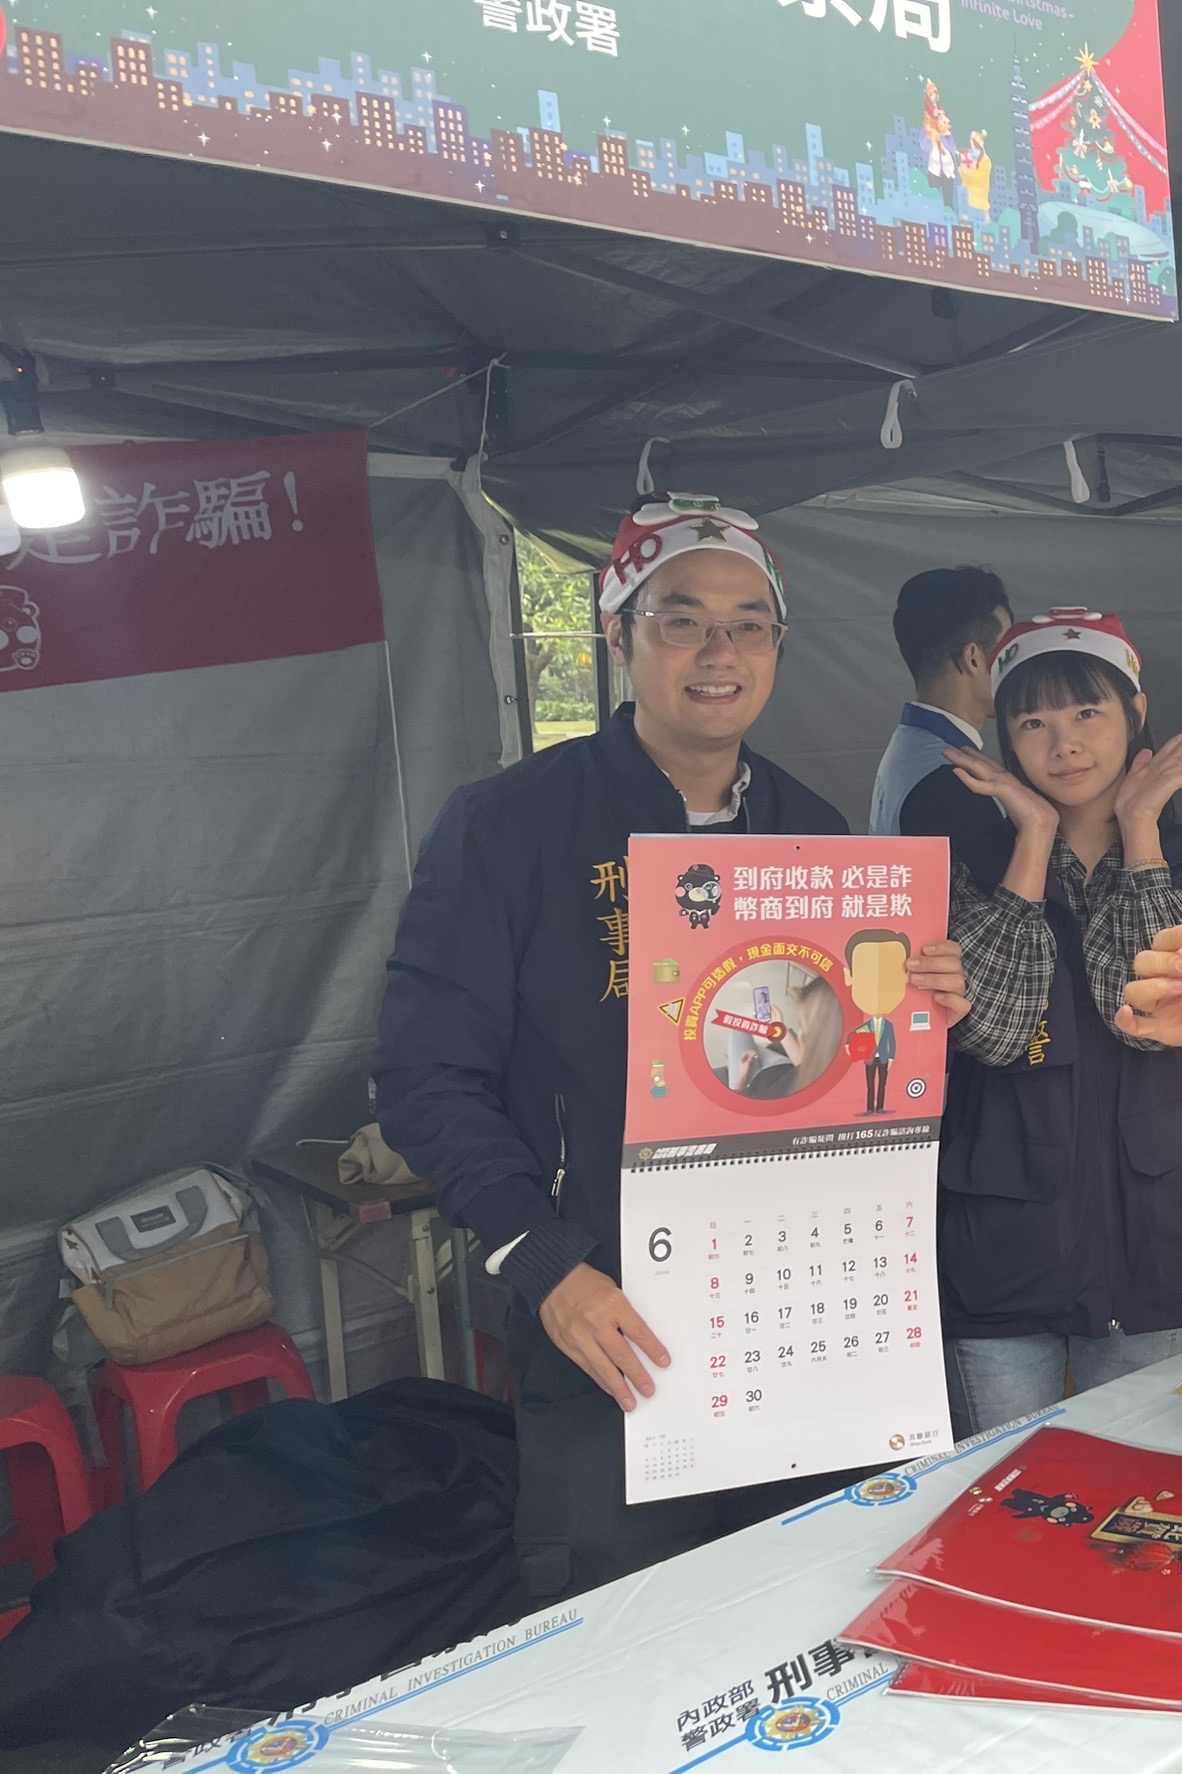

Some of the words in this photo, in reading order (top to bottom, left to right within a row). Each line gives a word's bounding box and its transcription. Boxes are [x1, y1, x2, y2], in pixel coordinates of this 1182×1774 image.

[780, 0, 951, 53] 局
[1013, 9, 1043, 30] Love
[733, 866, 834, 891] 到府收款
[841, 864, 912, 890] 必是詐
[733, 896, 834, 921] 幣商到府
[841, 893, 912, 919] 就是欺
[649, 1227, 672, 1262] 6
[712, 1238, 716, 1250] 1
[745, 1235, 753, 1246] 2
[778, 1231, 786, 1242] 3
[811, 1227, 819, 1238] 4
[844, 1223, 852, 1234] 5
[875, 1220, 883, 1231] 6
[906, 1216, 914, 1227] 7
[710, 1277, 719, 1289] 8
[745, 1273, 753, 1285] 9
[777, 1268, 791, 1281] 10
[809, 1264, 822, 1276] 11
[842, 1260, 856, 1272] 12
[874, 1256, 887, 1268] 13
[904, 1252, 918, 1264] 14
[710, 1316, 725, 1329] 15
[744, 1311, 759, 1324] 16
[778, 1306, 792, 1319] 17
[811, 1302, 825, 1315] 18
[844, 1298, 857, 1310] 19
[873, 1294, 888, 1306] 20
[904, 1289, 918, 1302] 21
[710, 1355, 726, 1369] 22
[744, 1350, 761, 1363] 23
[778, 1345, 794, 1358] 24
[811, 1340, 826, 1353] 25
[844, 1335, 859, 1348] 26
[875, 1331, 890, 1344] 27
[906, 1326, 922, 1339] 28
[711, 1395, 728, 1408] 29
[746, 1389, 762, 1402] 30
[954, 1418, 1022, 1454] INVESTIGATION
[324, 1688, 398, 1726] CRIMINAL
[408, 1635, 517, 1691] INVESTIGATION
[524, 1609, 579, 1640] BUREAU
[826, 1663, 889, 1701] CRIMINAL
[677, 1680, 755, 1732] 內政部
[681, 1697, 762, 1752] 警政署
